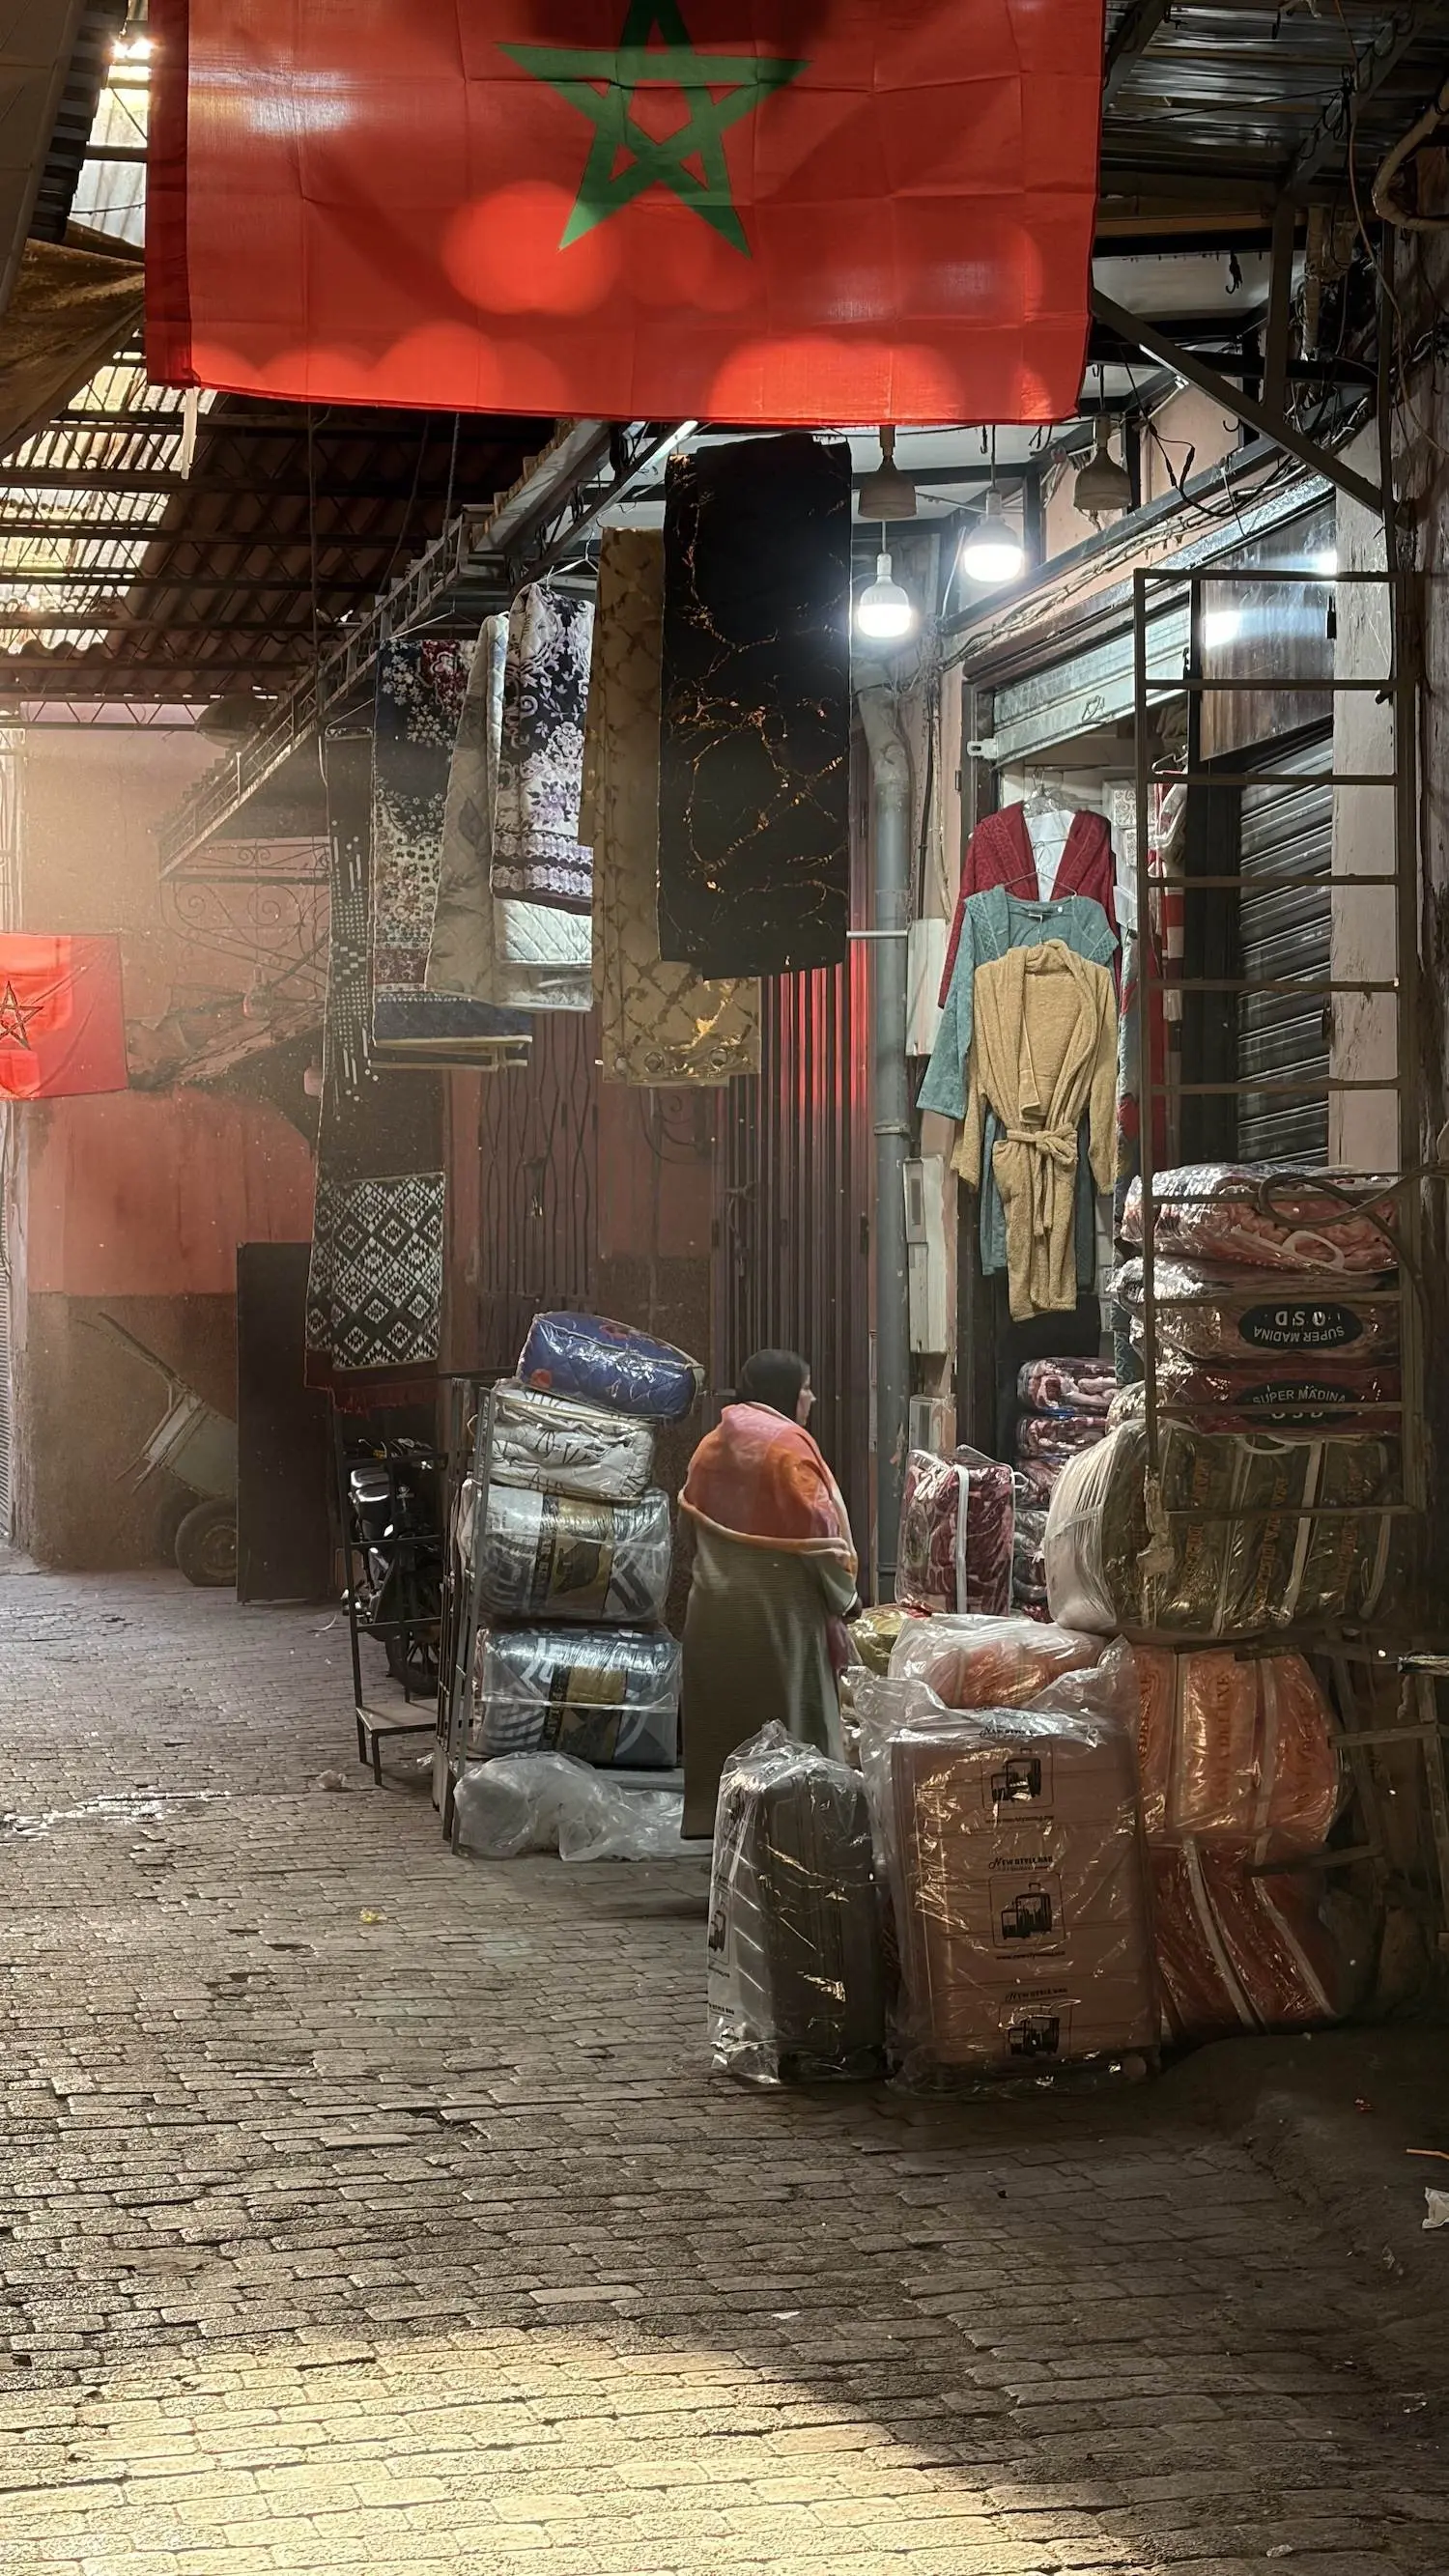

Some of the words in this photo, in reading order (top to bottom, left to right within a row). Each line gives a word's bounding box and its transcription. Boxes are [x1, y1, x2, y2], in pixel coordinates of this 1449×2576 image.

[1253, 1324, 1300, 1343] MADINA
[1303, 1325, 1346, 1343] SUPER
[1252, 1389, 1294, 1404] SUPER
[1297, 1389, 1346, 1403] MADINA
